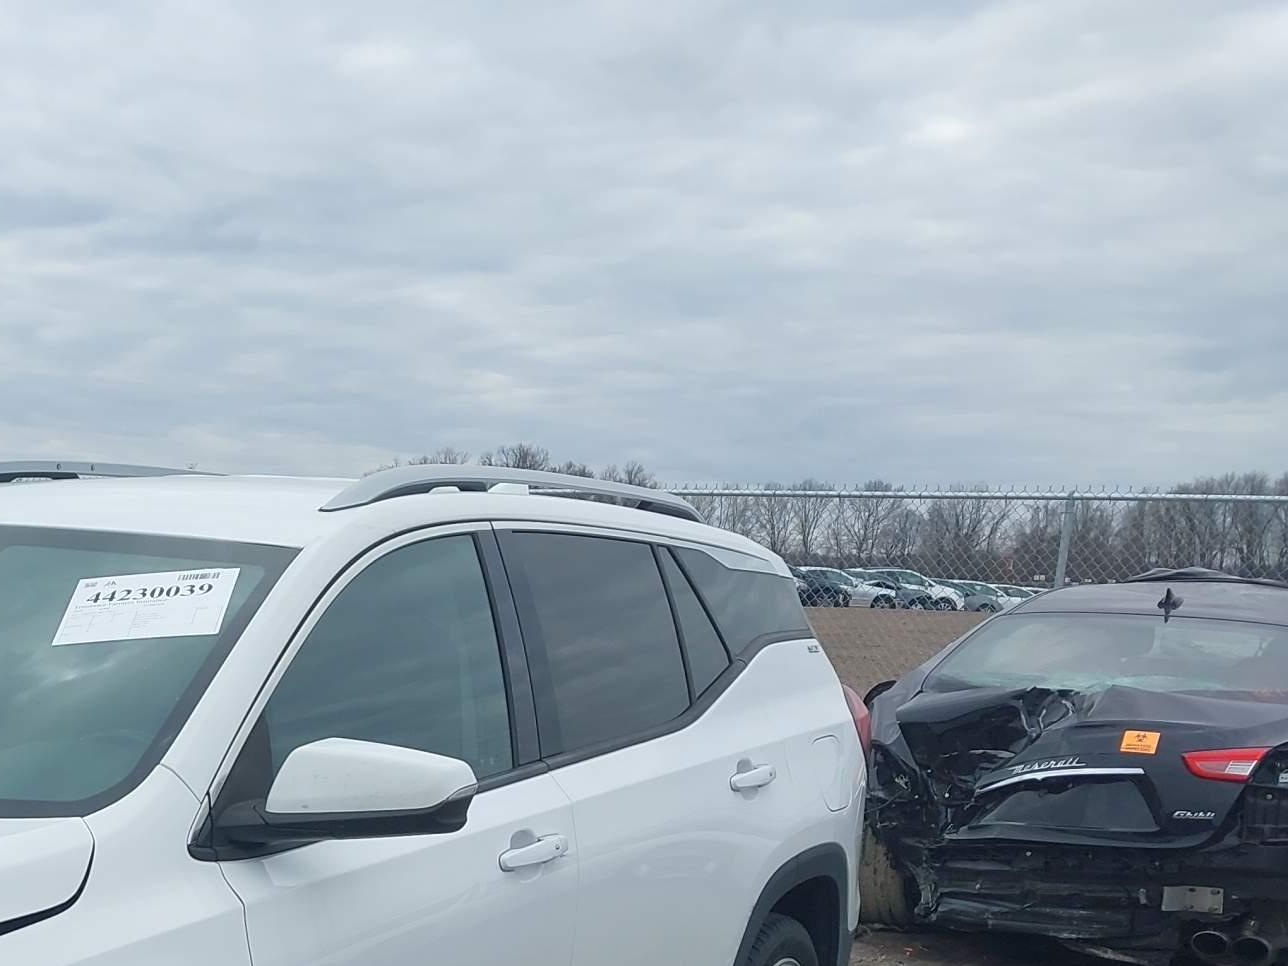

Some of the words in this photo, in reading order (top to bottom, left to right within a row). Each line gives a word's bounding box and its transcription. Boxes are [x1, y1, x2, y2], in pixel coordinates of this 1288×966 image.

[85, 582, 214, 604] 44230039
[1008, 756, 1087, 775] Maserati
[1172, 810, 1216, 819] Ghibli
